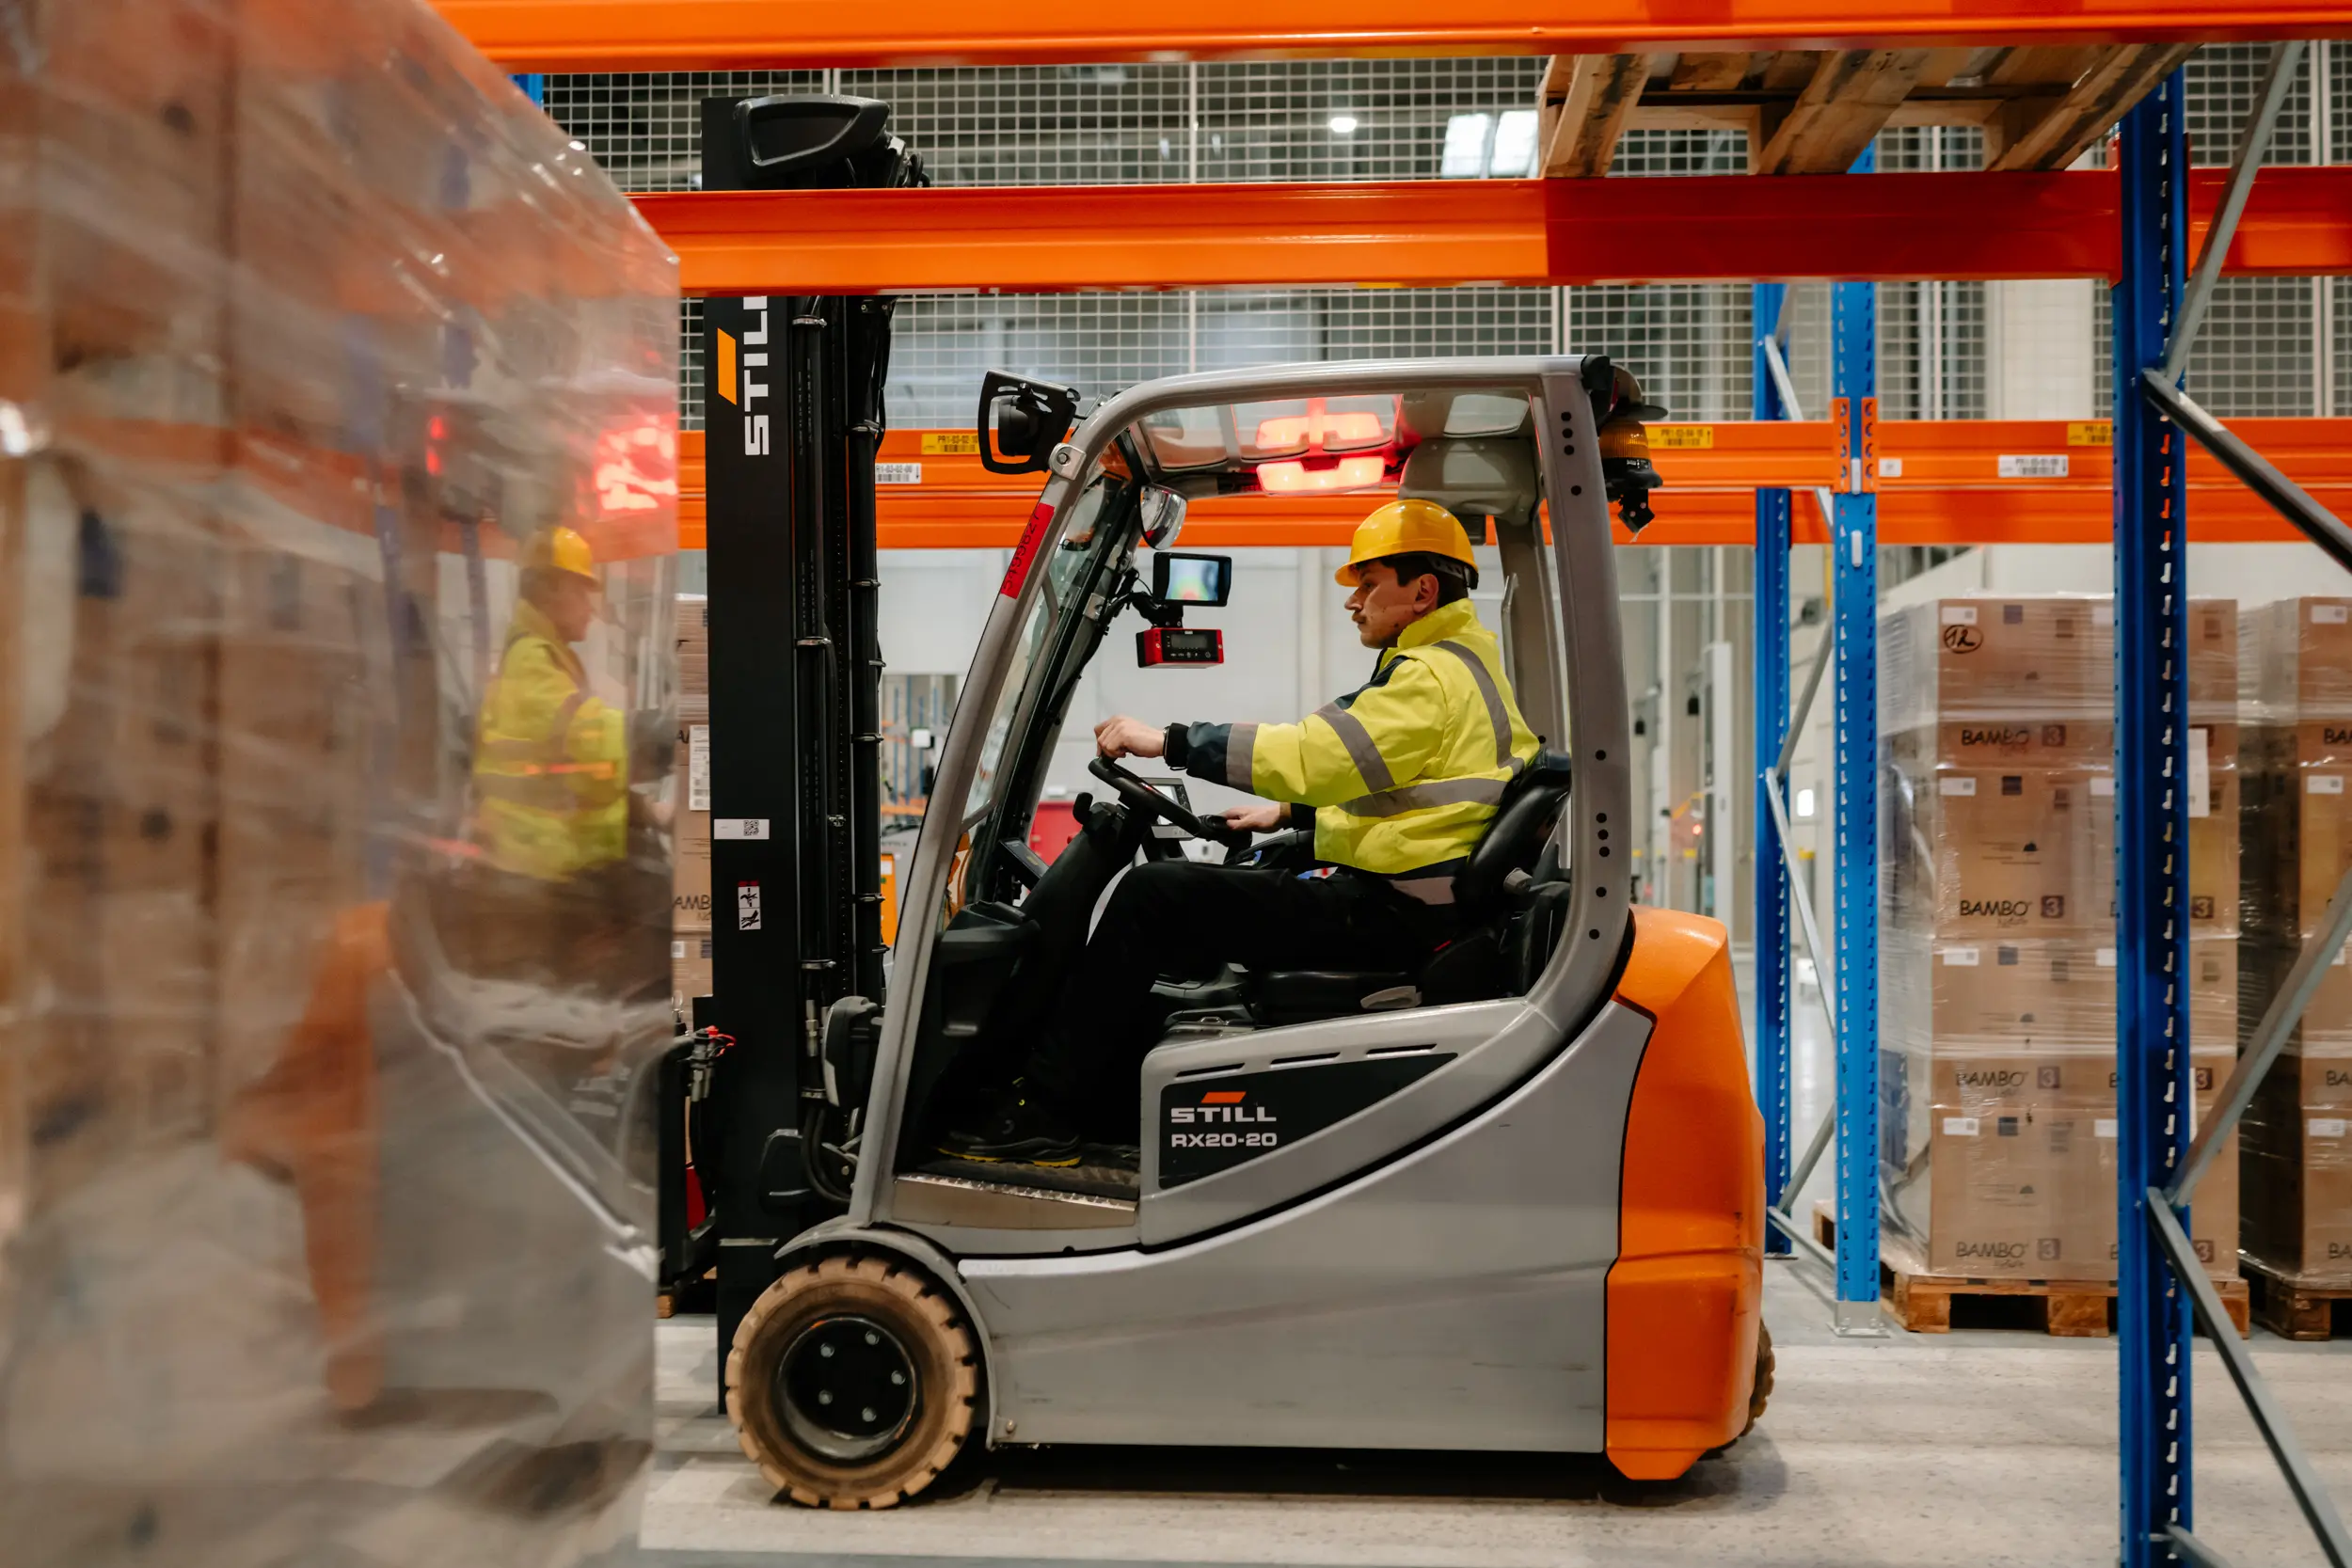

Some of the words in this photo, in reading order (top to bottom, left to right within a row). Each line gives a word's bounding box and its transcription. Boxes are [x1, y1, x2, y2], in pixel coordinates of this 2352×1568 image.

[1962, 729, 2029, 746] BAMBO
[1960, 899, 2029, 916] BAMBO
[2043, 897, 2060, 917] 3
[2195, 897, 2211, 917] 3
[1956, 1070, 2026, 1087] BAMBO
[1171, 1107, 1277, 1123] STILL
[1171, 1132, 1278, 1148] RX20-20
[1956, 1241, 2026, 1258] BAMBO
[2040, 1239, 2058, 1259] 3
